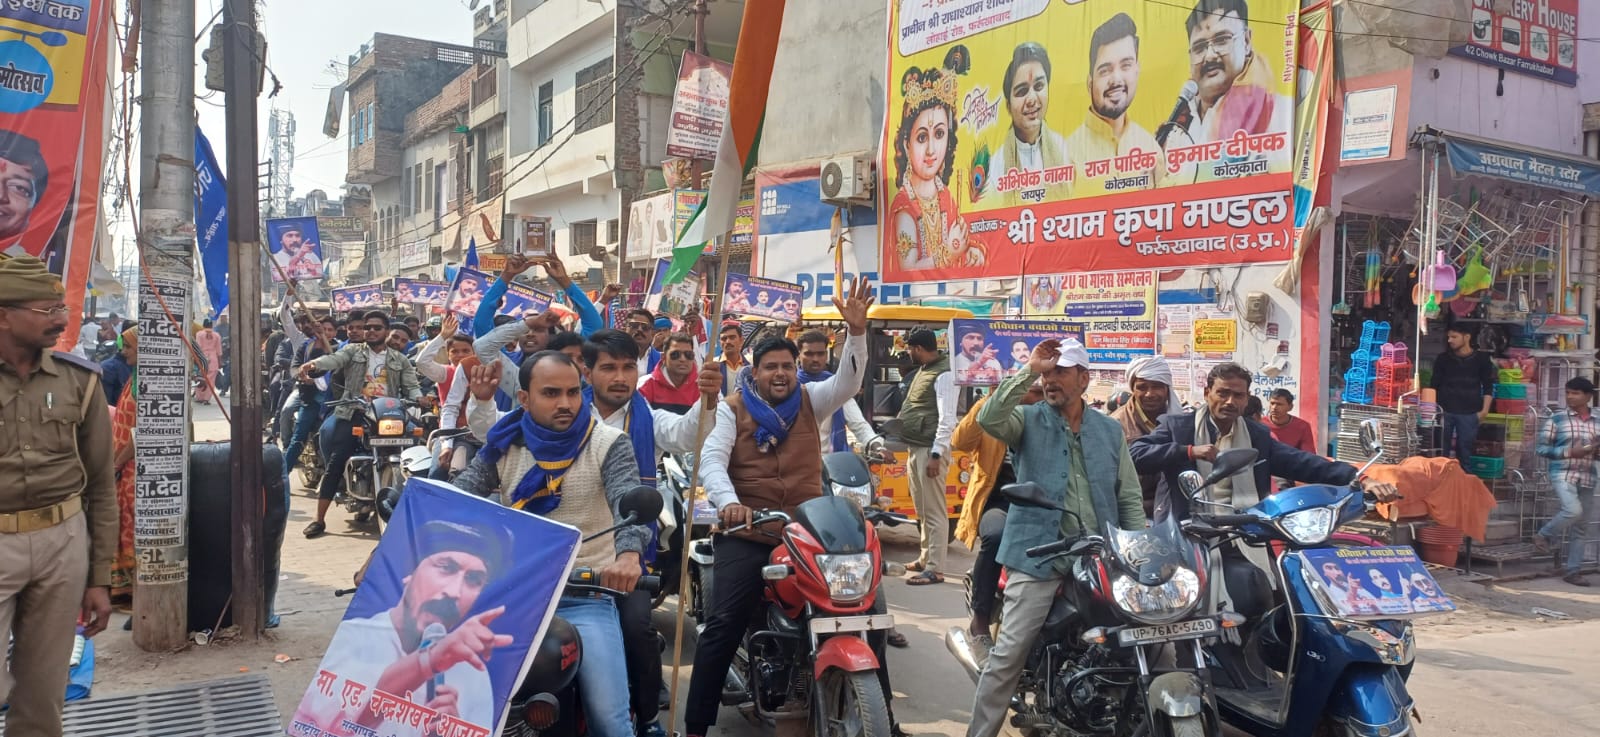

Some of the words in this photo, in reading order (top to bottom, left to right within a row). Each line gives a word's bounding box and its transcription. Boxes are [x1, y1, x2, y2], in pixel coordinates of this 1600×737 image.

[48, 2, 83, 20] तक
[902, 18, 926, 40] प्राचीन
[928, 12, 939, 28] श्री
[941, 2, 984, 25] राधाश्याम
[1538, 0, 1576, 34] HOUSE
[1283, 51, 1295, 83] Niyati
[1465, 45, 1475, 55] 4/2
[1476, 48, 1497, 62] Chowk
[1498, 54, 1517, 66] Bazar
[1517, 59, 1554, 75] Farrukhabad
[0, 63, 46, 94] मोत्सव
[1085, 159, 1110, 177] राज
[1114, 147, 1157, 173] पारिक
[1167, 142, 1223, 172] कुमार
[1226, 129, 1287, 156] दीपक
[997, 167, 1041, 191] अभिषेक
[1044, 165, 1074, 184] नामा
[1214, 159, 1268, 177] कोलकाता
[1479, 152, 1525, 171] अग्रवाल
[1529, 157, 1556, 176] मैटल
[1558, 164, 1582, 181] स्टोर
[1021, 188, 1046, 201] जयपुर
[1105, 175, 1149, 190] कोलकाता
[969, 217, 999, 233] आयोजक
[1007, 208, 1037, 244] श्री
[1042, 210, 1107, 242] श्याम
[1113, 203, 1175, 246] कृपा
[1182, 190, 1291, 228] मण्डल
[1230, 229, 1290, 252] (उ.प्र.)
[162, 366, 184, 375] रोग
[138, 395, 183, 417] डा.देव
[160, 446, 181, 455] रोग
[136, 475, 181, 498] डा.देव
[316, 669, 337, 698] मा.
[341, 679, 366, 709] एड.
[370, 690, 438, 734] चन्द्रशेखर
